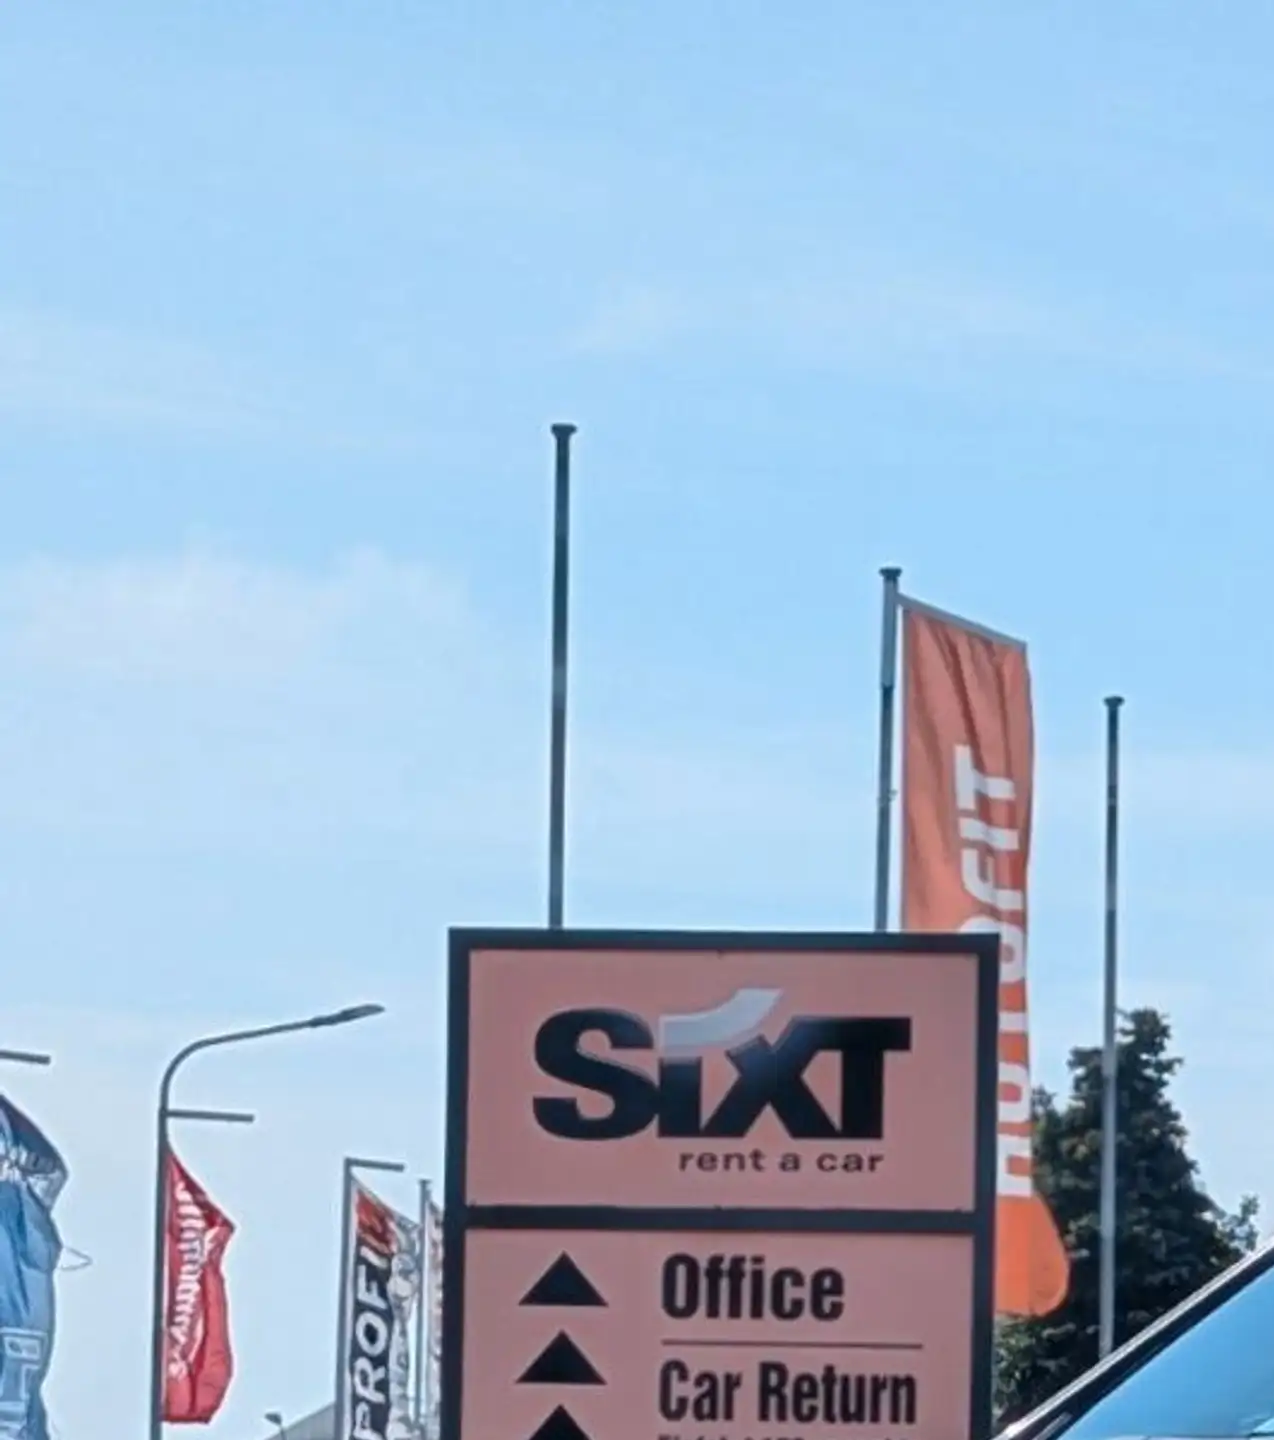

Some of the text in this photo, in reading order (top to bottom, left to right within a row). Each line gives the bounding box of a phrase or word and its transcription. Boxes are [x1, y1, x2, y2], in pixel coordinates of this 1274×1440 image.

[678, 1149, 884, 1174] rent a car
[661, 1253, 845, 1321] Office
[658, 1359, 917, 1424] Car Return
